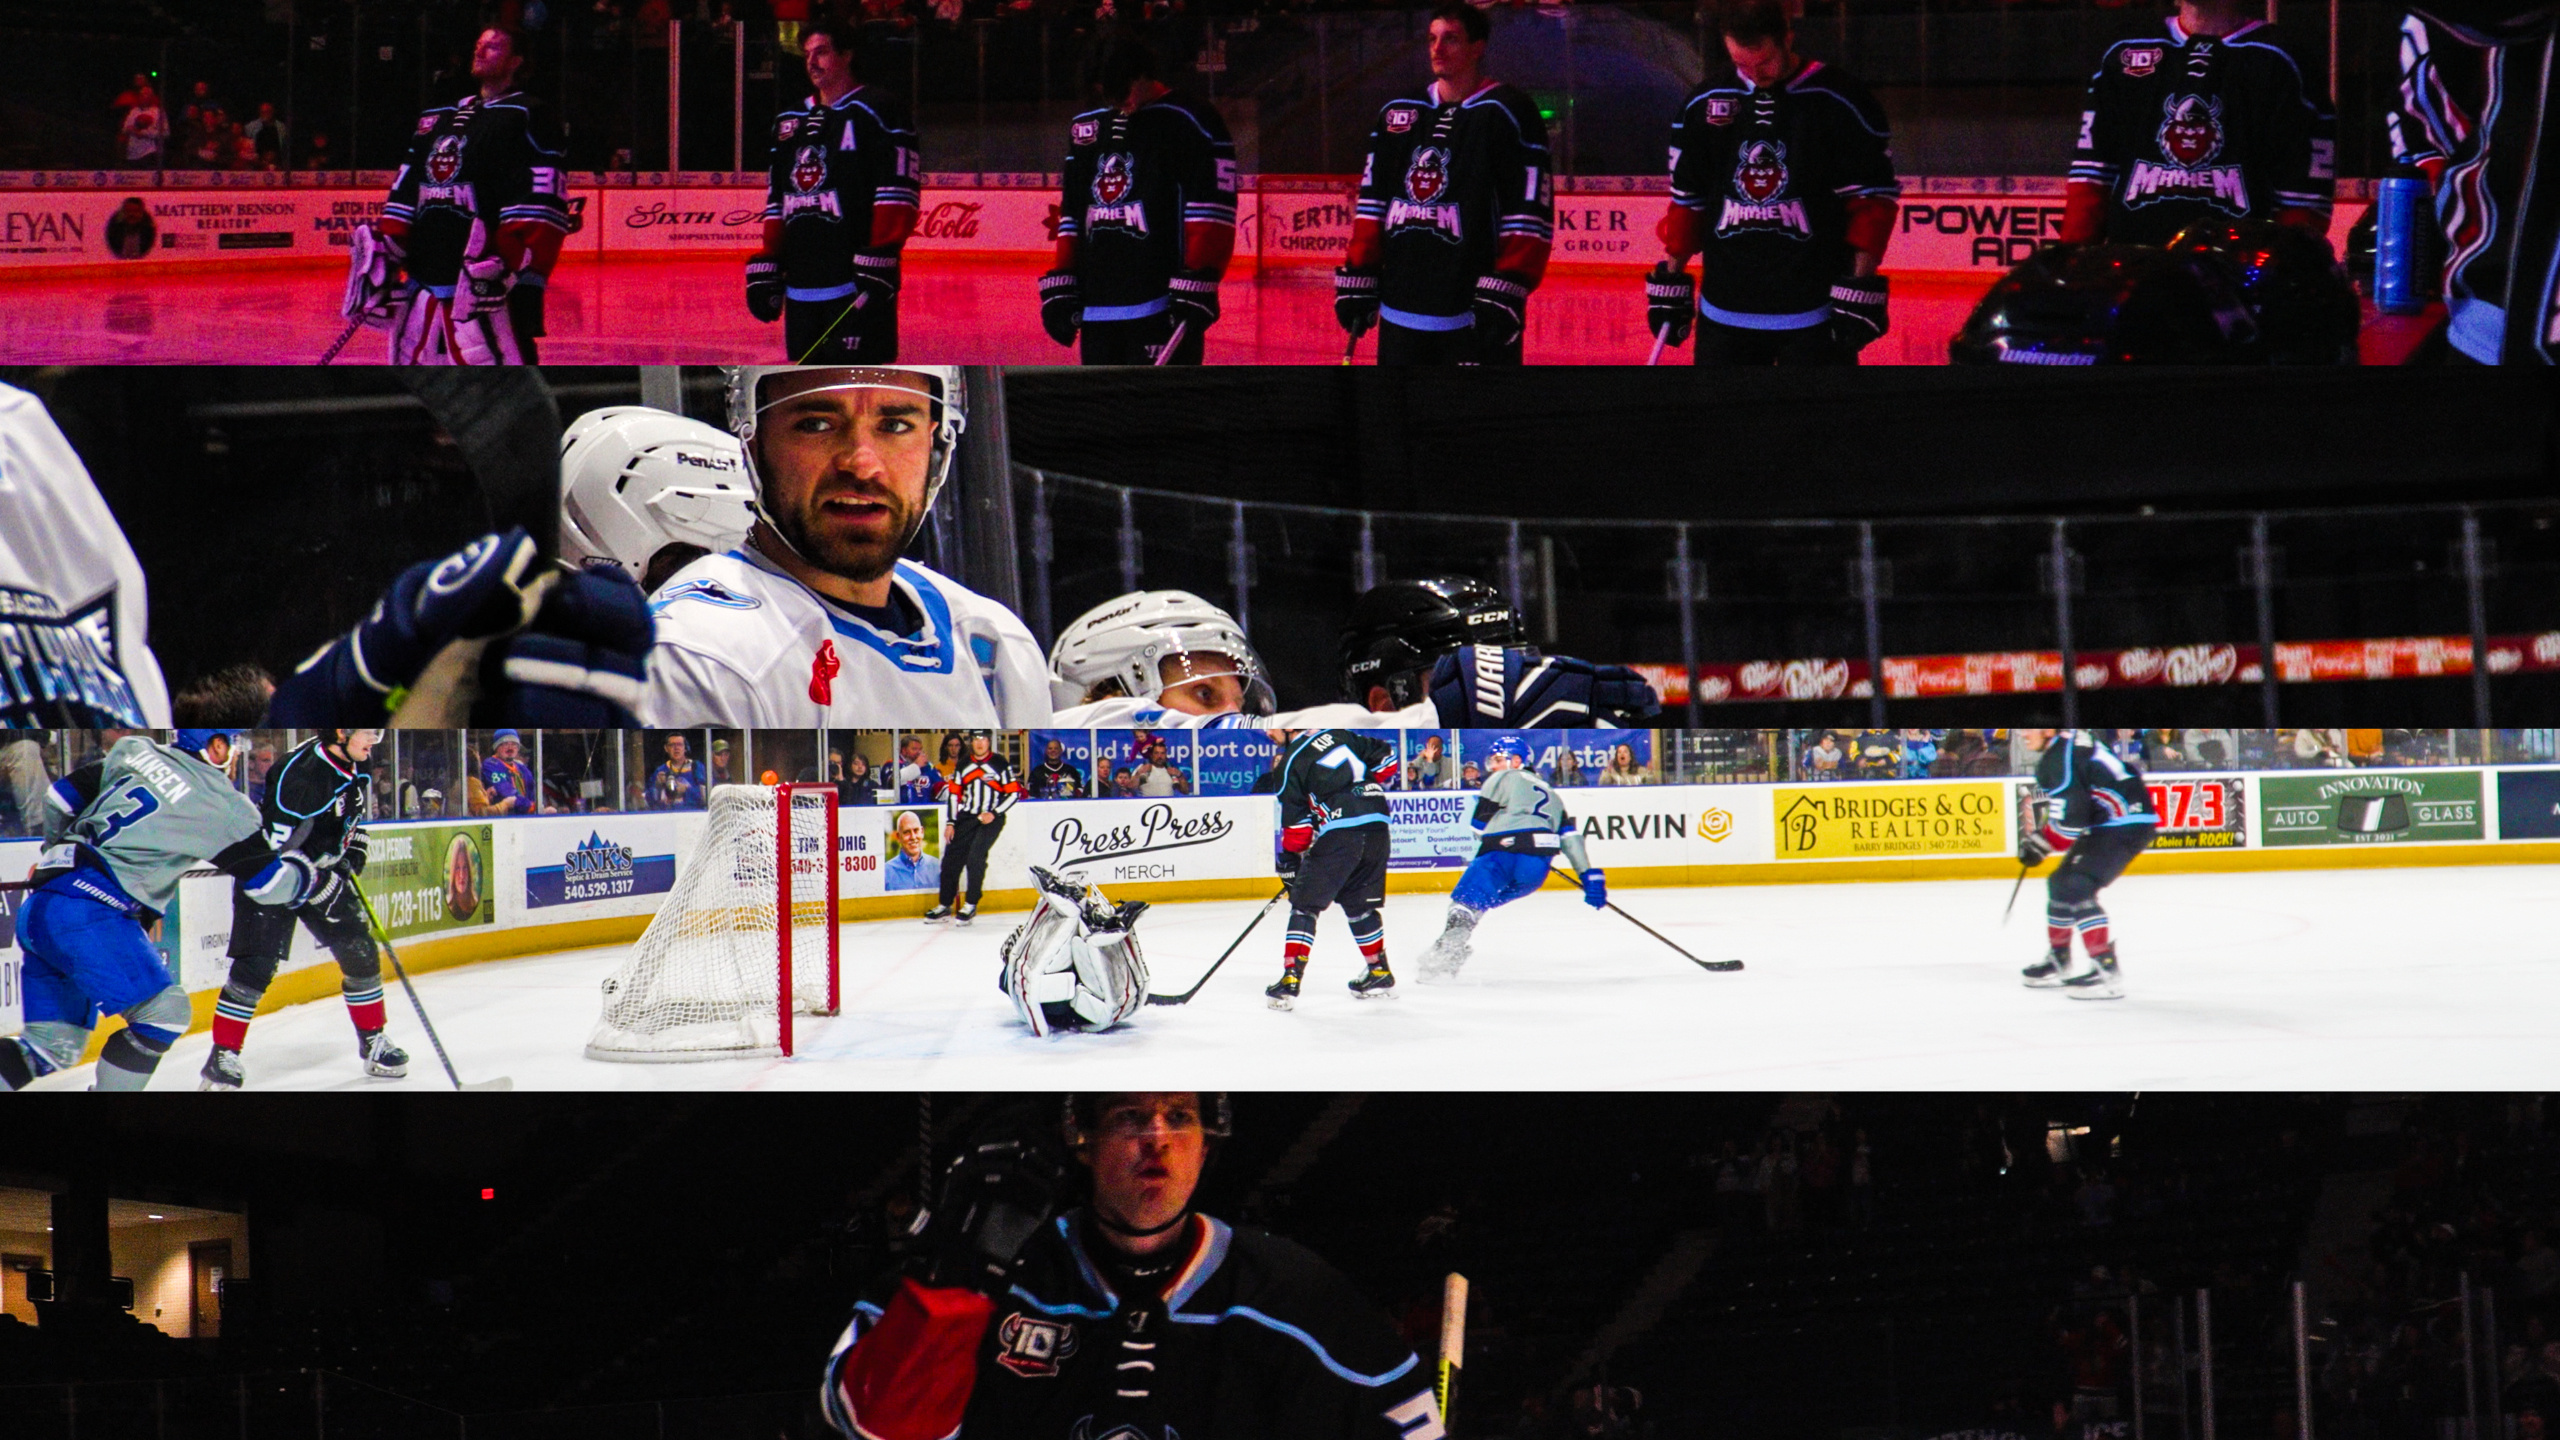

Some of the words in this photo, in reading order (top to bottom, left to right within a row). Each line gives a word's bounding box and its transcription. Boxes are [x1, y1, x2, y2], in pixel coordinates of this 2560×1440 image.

[840, 120, 857, 150] A
[2126, 162, 2247, 209] MAYHEM
[154, 203, 232, 216] MATTHEW
[236, 203, 295, 215] BENSON
[332, 202, 364, 215] CATCH
[367, 201, 385, 215] EVE
[626, 202, 716, 228] SIXTH
[1292, 204, 1351, 233] ERTH
[1386, 198, 1461, 237] MAYHEM
[1718, 198, 1810, 234] MAYHEM
[0, 212, 83, 242] EYAN
[314, 217, 381, 231] MAYH
[1558, 209, 1629, 231] KER
[1902, 204, 2066, 237] POWER
[1280, 235, 1350, 251] CHIROPR
[1565, 239, 1630, 252] GROUP
[1972, 236, 2060, 266] AD
[1467, 611, 1509, 626] CCM
[1351, 658, 1381, 674] CCM
[1166, 741, 1241, 763] upport
[1242, 744, 1279, 758] our
[1311, 733, 1335, 753] KUP
[1315, 743, 1368, 783] 7
[125, 750, 192, 805] JANSEN
[2318, 775, 2426, 800] INNOVATION
[1387, 796, 1465, 812] WNHOME
[1532, 785, 1551, 820] 2
[1834, 796, 1927, 819] BRIDGES
[1935, 793, 1953, 816] &
[2149, 783, 2225, 828] 97.3
[2418, 806, 2474, 821] GLASS
[1391, 811, 1462, 825] ARMACY
[1569, 813, 1686, 840] ARVIN
[1851, 817, 1982, 839] REALTORS
[2275, 810, 2320, 825] AUTO
[838, 835, 866, 851] OHIG
[1050, 817, 1137, 866] Press
[1141, 803, 1233, 848] Press
[2199, 831, 2235, 847] ROCK!
[2355, 833, 2372, 842] EST
[1854, 842, 1881, 852] BARRY
[1884, 841, 1922, 851] BRIDGES
[564, 846, 633, 876] SINK'S
[1114, 864, 1175, 880] MERCH
[610, 869, 634, 878] Service
[564, 879, 635, 901] 540.529.1317
[391, 886, 443, 928] 238-1113
[1015, 1321, 1055, 1357] 10
